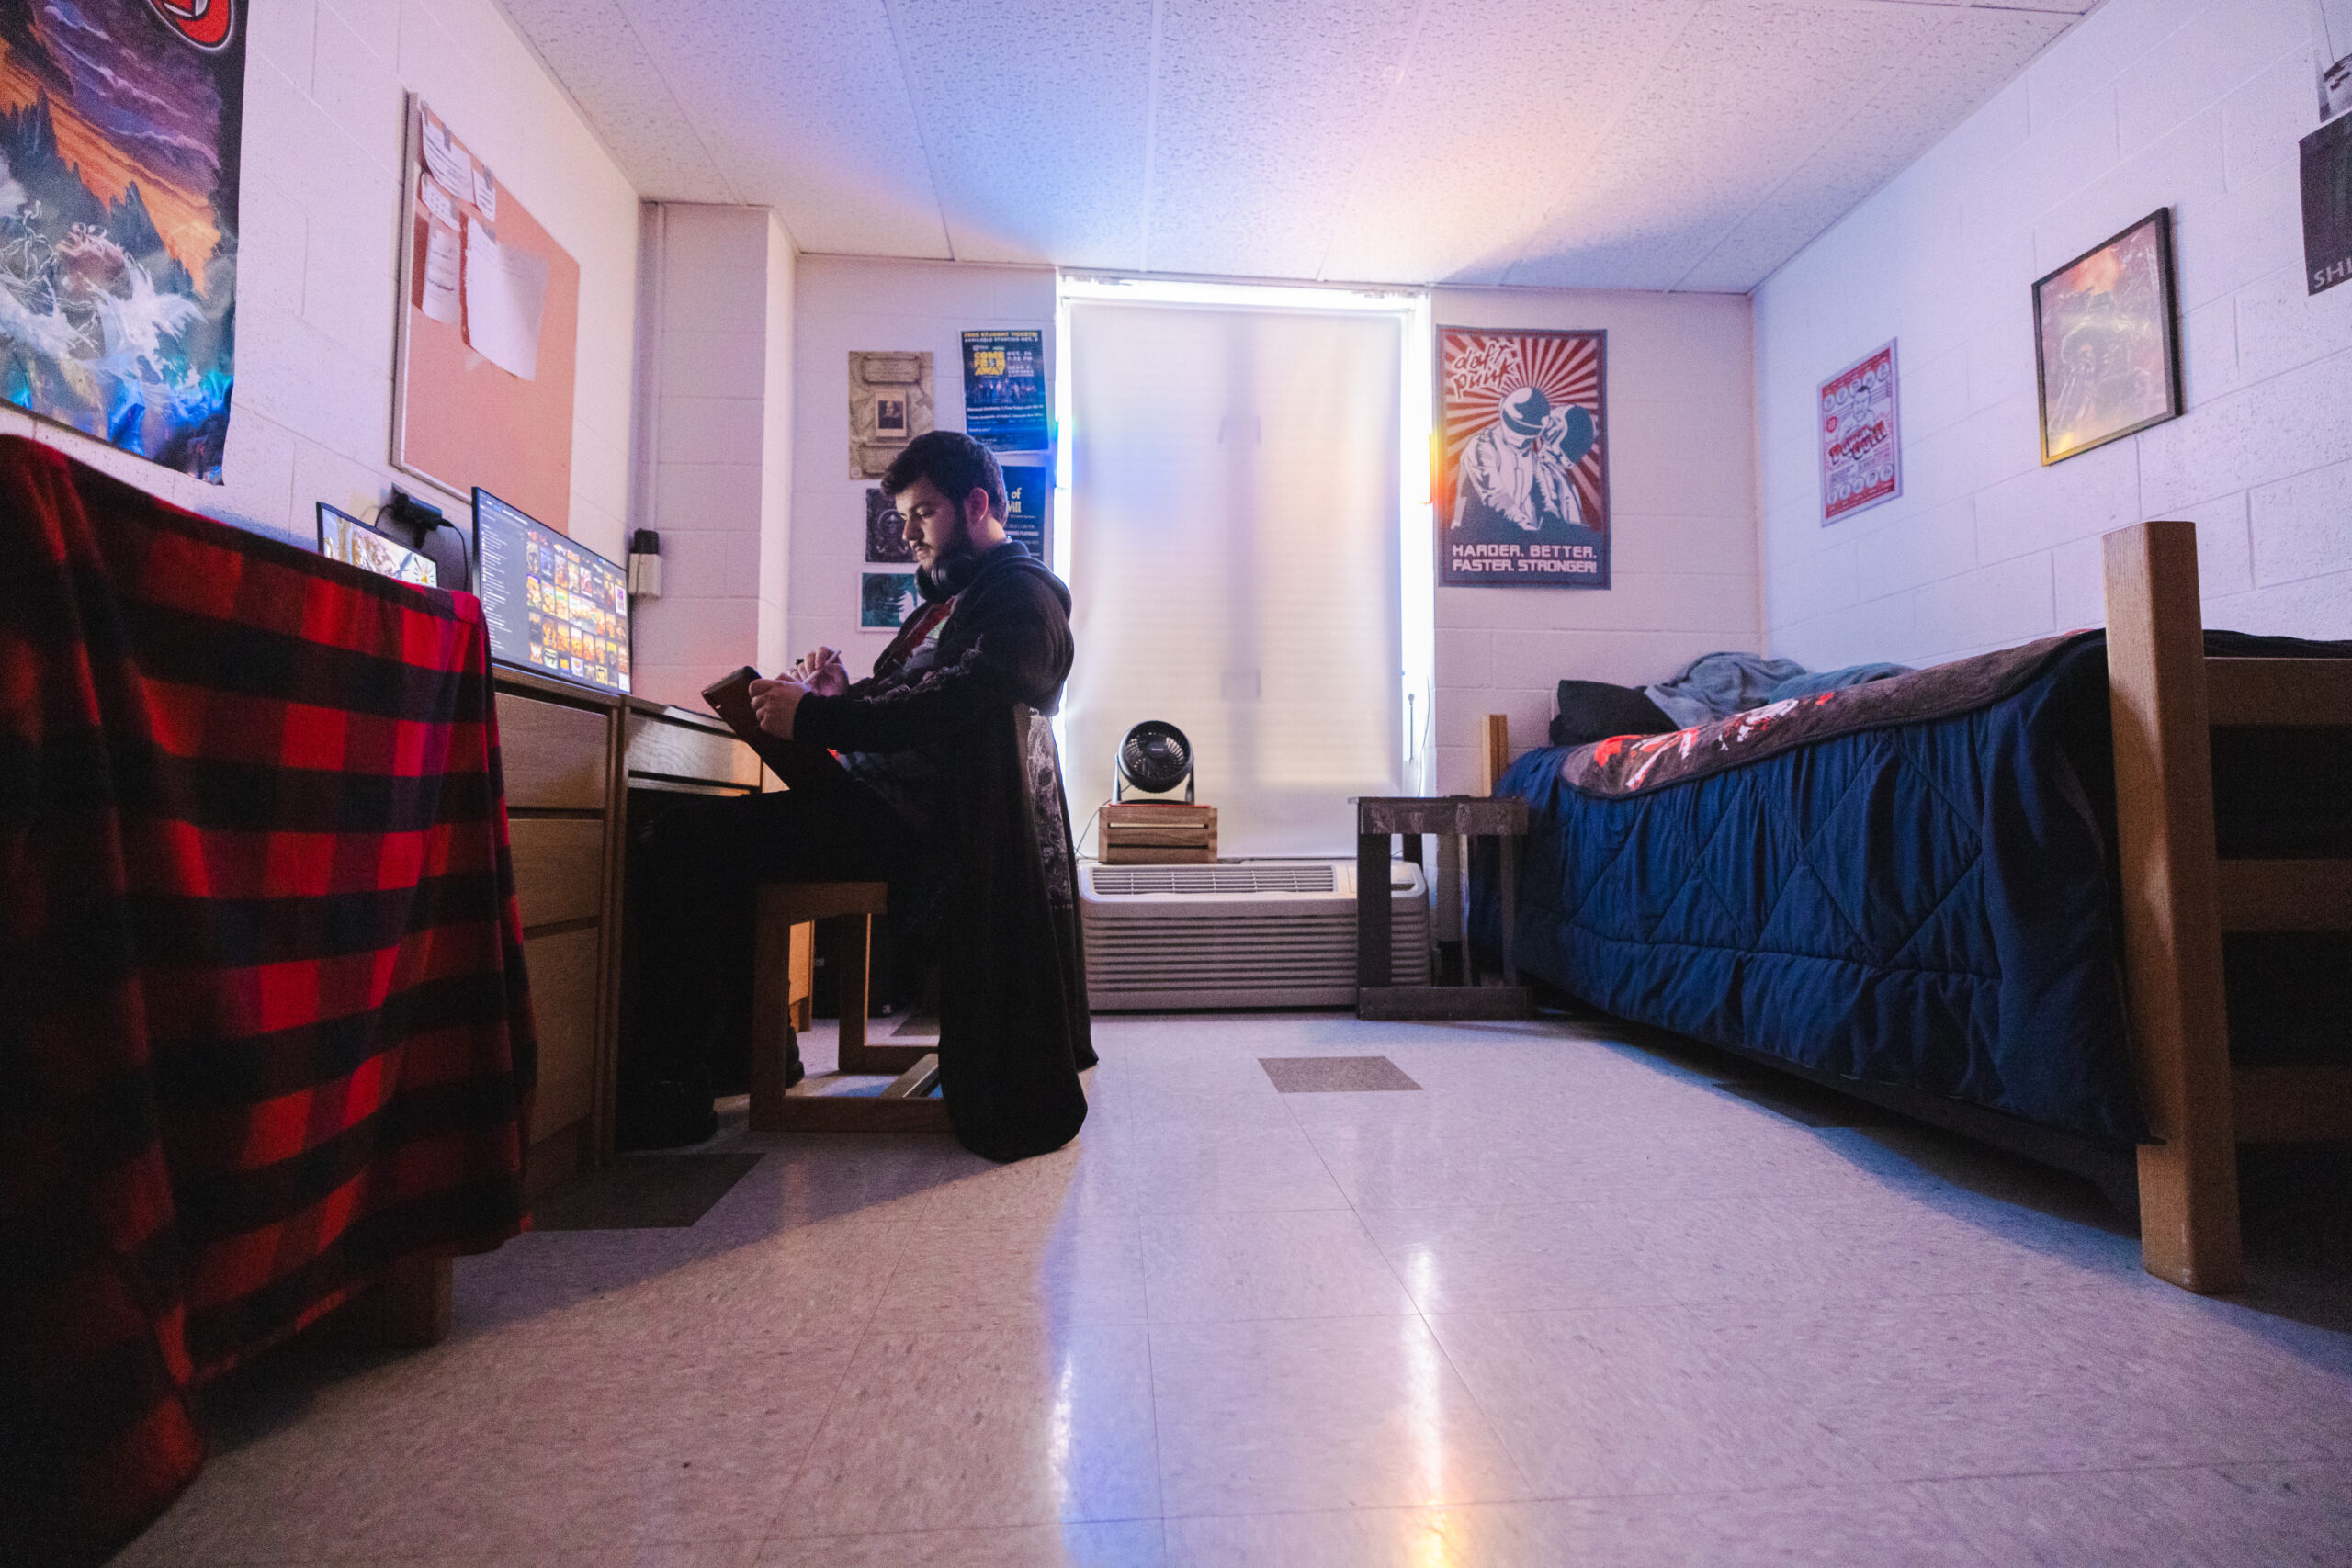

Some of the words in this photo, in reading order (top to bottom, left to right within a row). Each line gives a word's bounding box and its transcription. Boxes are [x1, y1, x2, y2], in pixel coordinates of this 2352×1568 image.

[974, 351, 1004, 359] COME
[1453, 341, 1512, 369] daft
[1452, 355, 1514, 400] punk
[1011, 487, 1022, 499] of
[1453, 544, 1524, 558] HARDER.
[1530, 544, 1598, 558] BETTER.
[1453, 559, 1515, 571] FASTER.
[1518, 559, 1598, 574] STRONGER!
